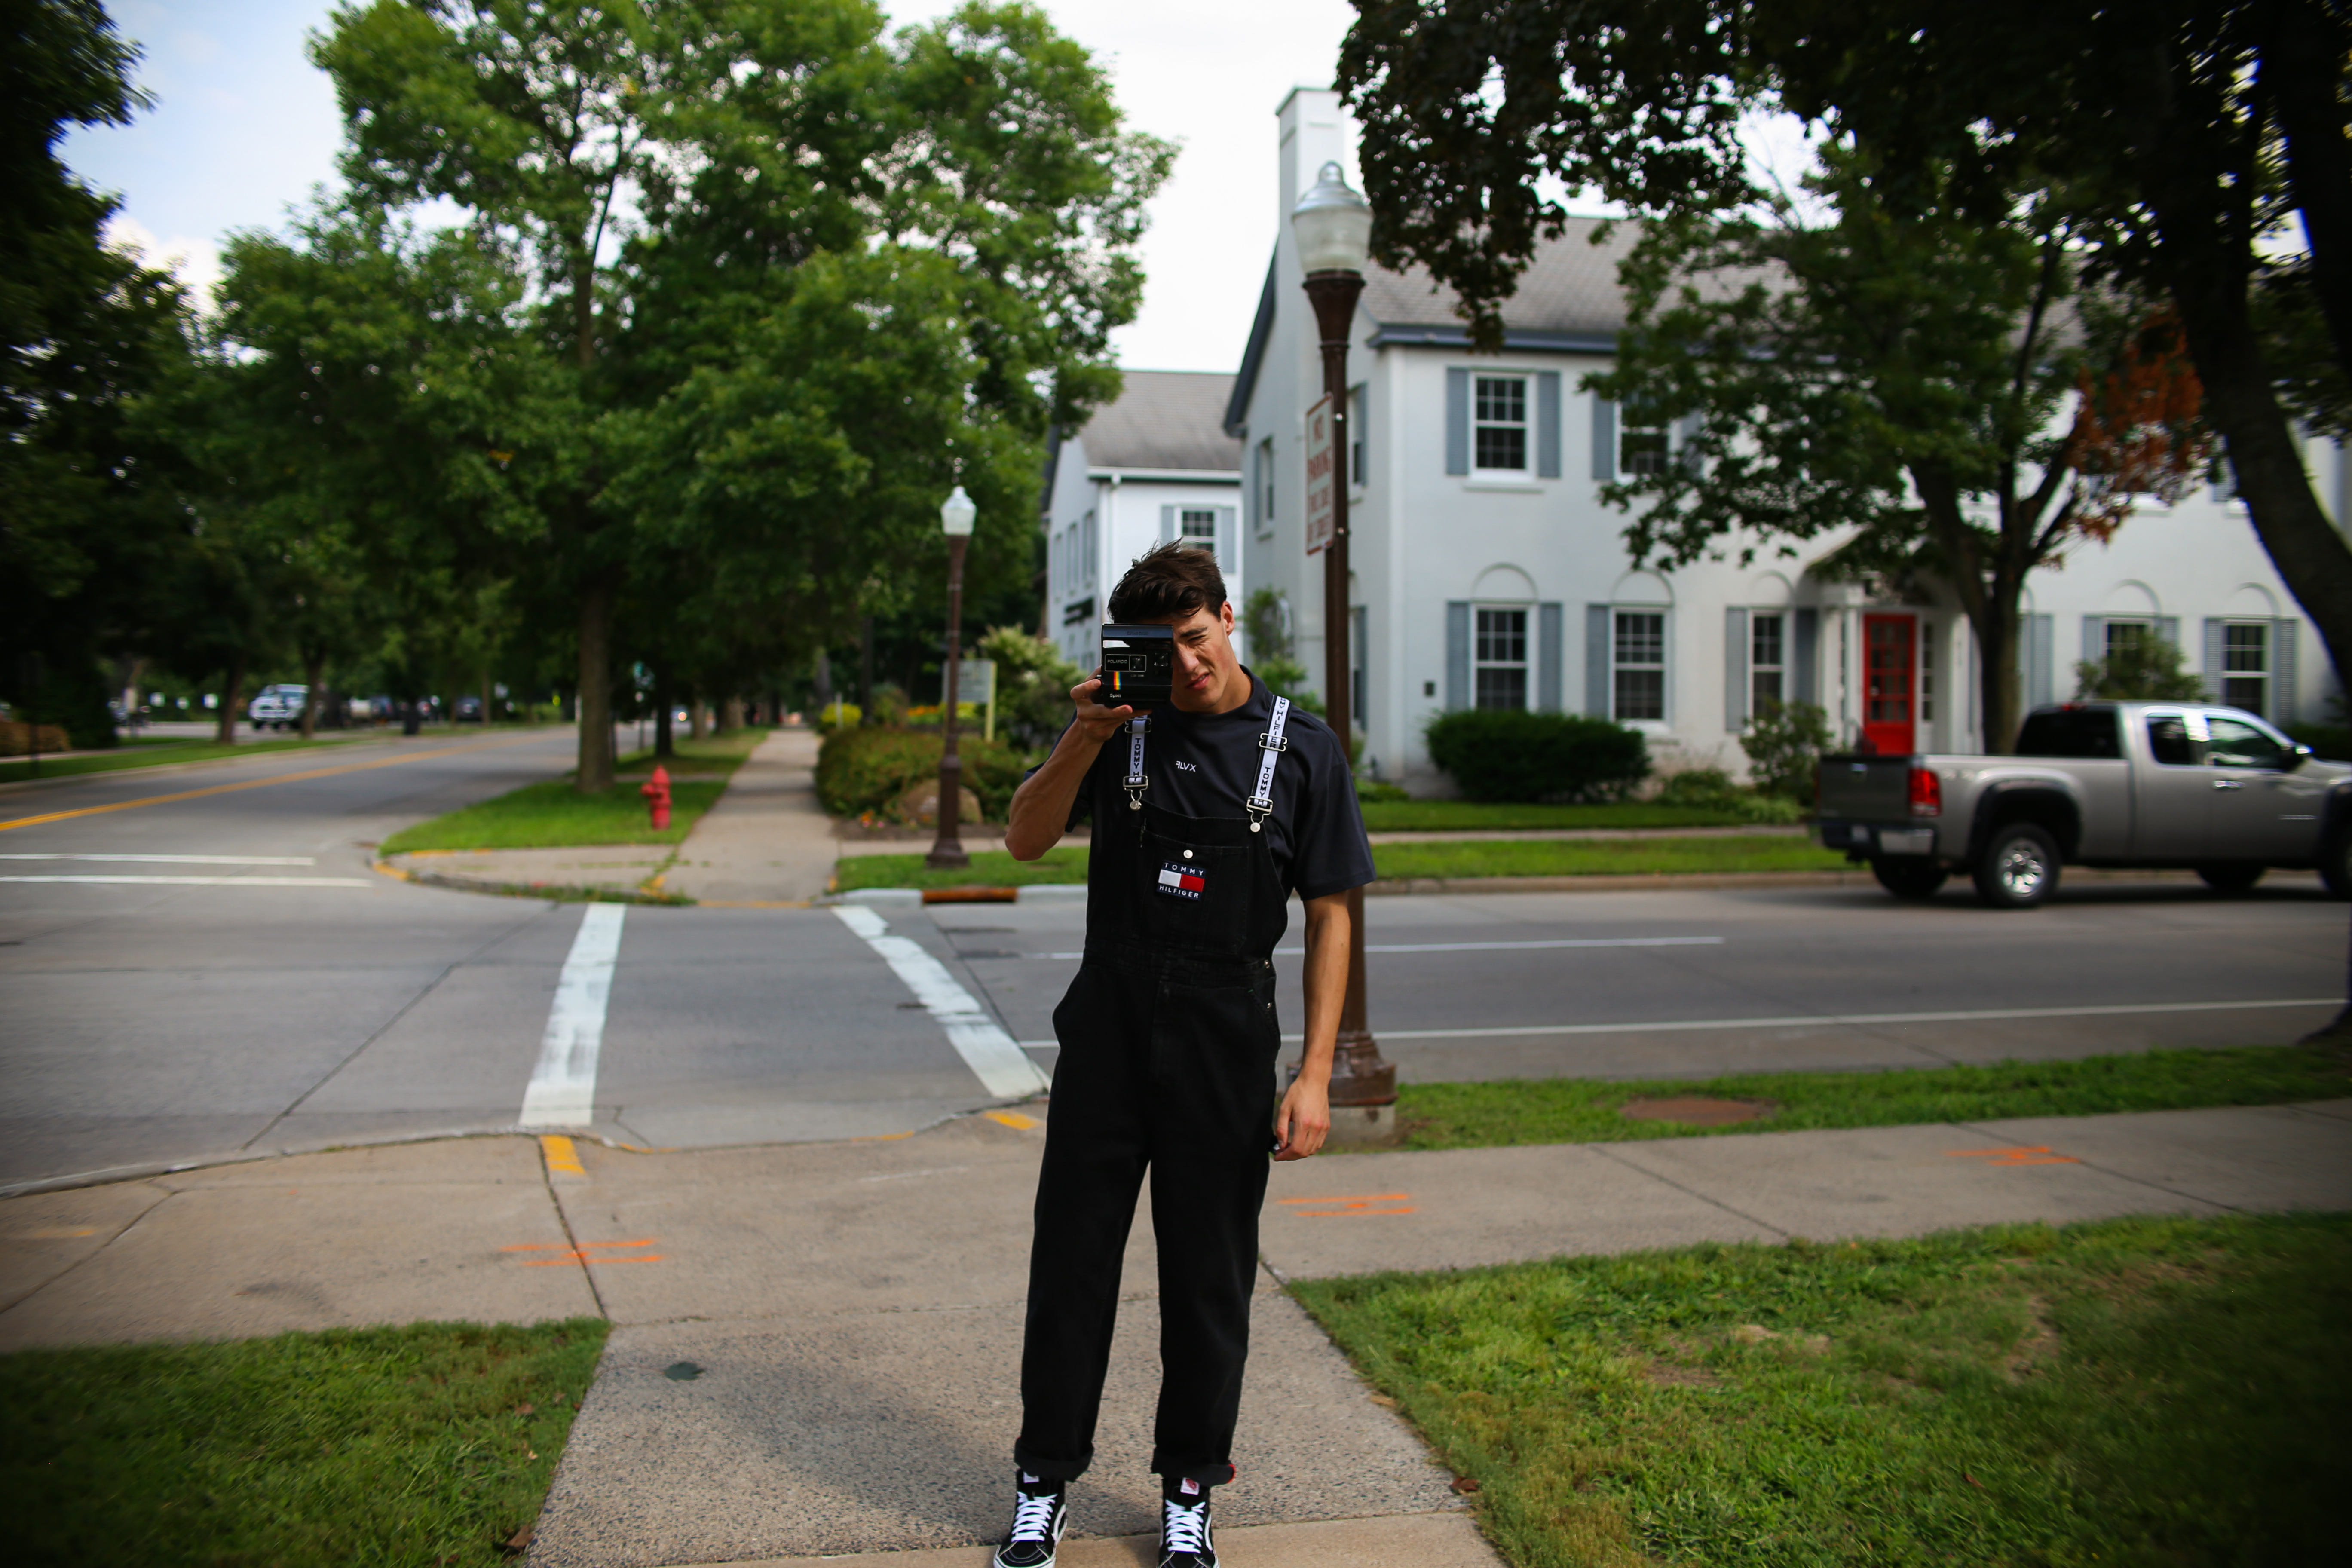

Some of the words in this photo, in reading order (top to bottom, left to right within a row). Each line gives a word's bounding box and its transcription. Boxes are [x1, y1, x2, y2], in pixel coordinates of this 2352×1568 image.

[1270, 710, 1283, 748] HILFIER
[1260, 767, 1271, 797] TOMMY
[1165, 863, 1203, 876] TOMMY
[1159, 885, 1199, 898] HILFIGER
